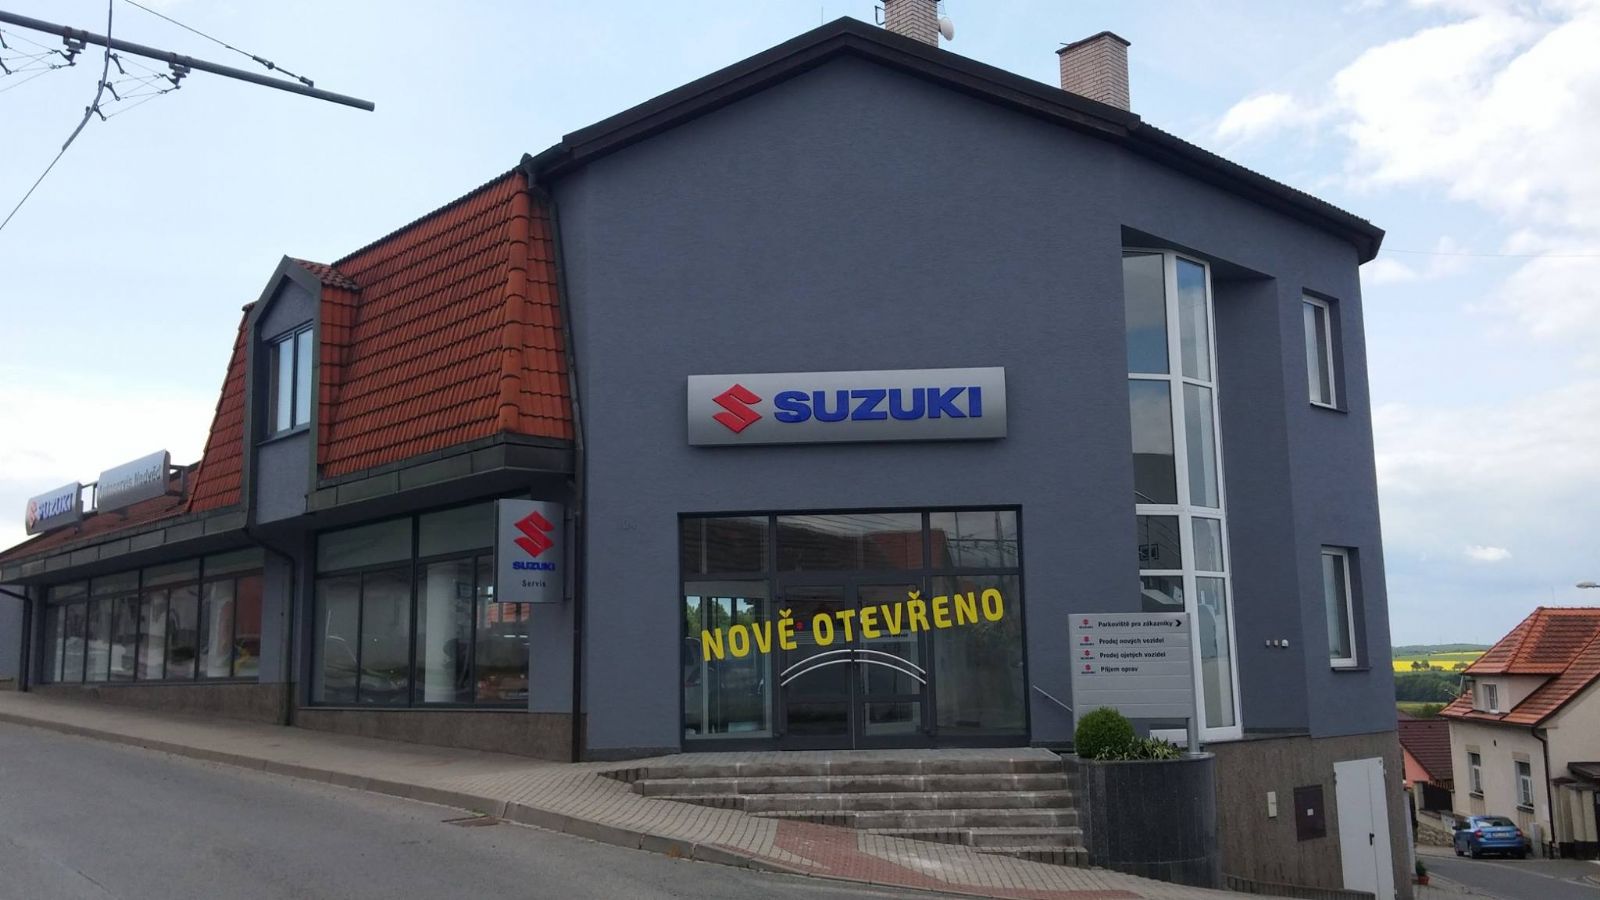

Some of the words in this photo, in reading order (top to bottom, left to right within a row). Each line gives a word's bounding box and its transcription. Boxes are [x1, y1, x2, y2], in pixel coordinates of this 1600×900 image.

[774, 386, 983, 424] SUZUKI
[37, 493, 74, 521] SUZUKI
[512, 561, 556, 571] SUZUKI
[522, 579, 546, 588] Servis
[701, 607, 798, 662] NOVĚ
[812, 588, 1005, 647] OTEVŘENO
[1098, 620, 1130, 628] Parkoviště
